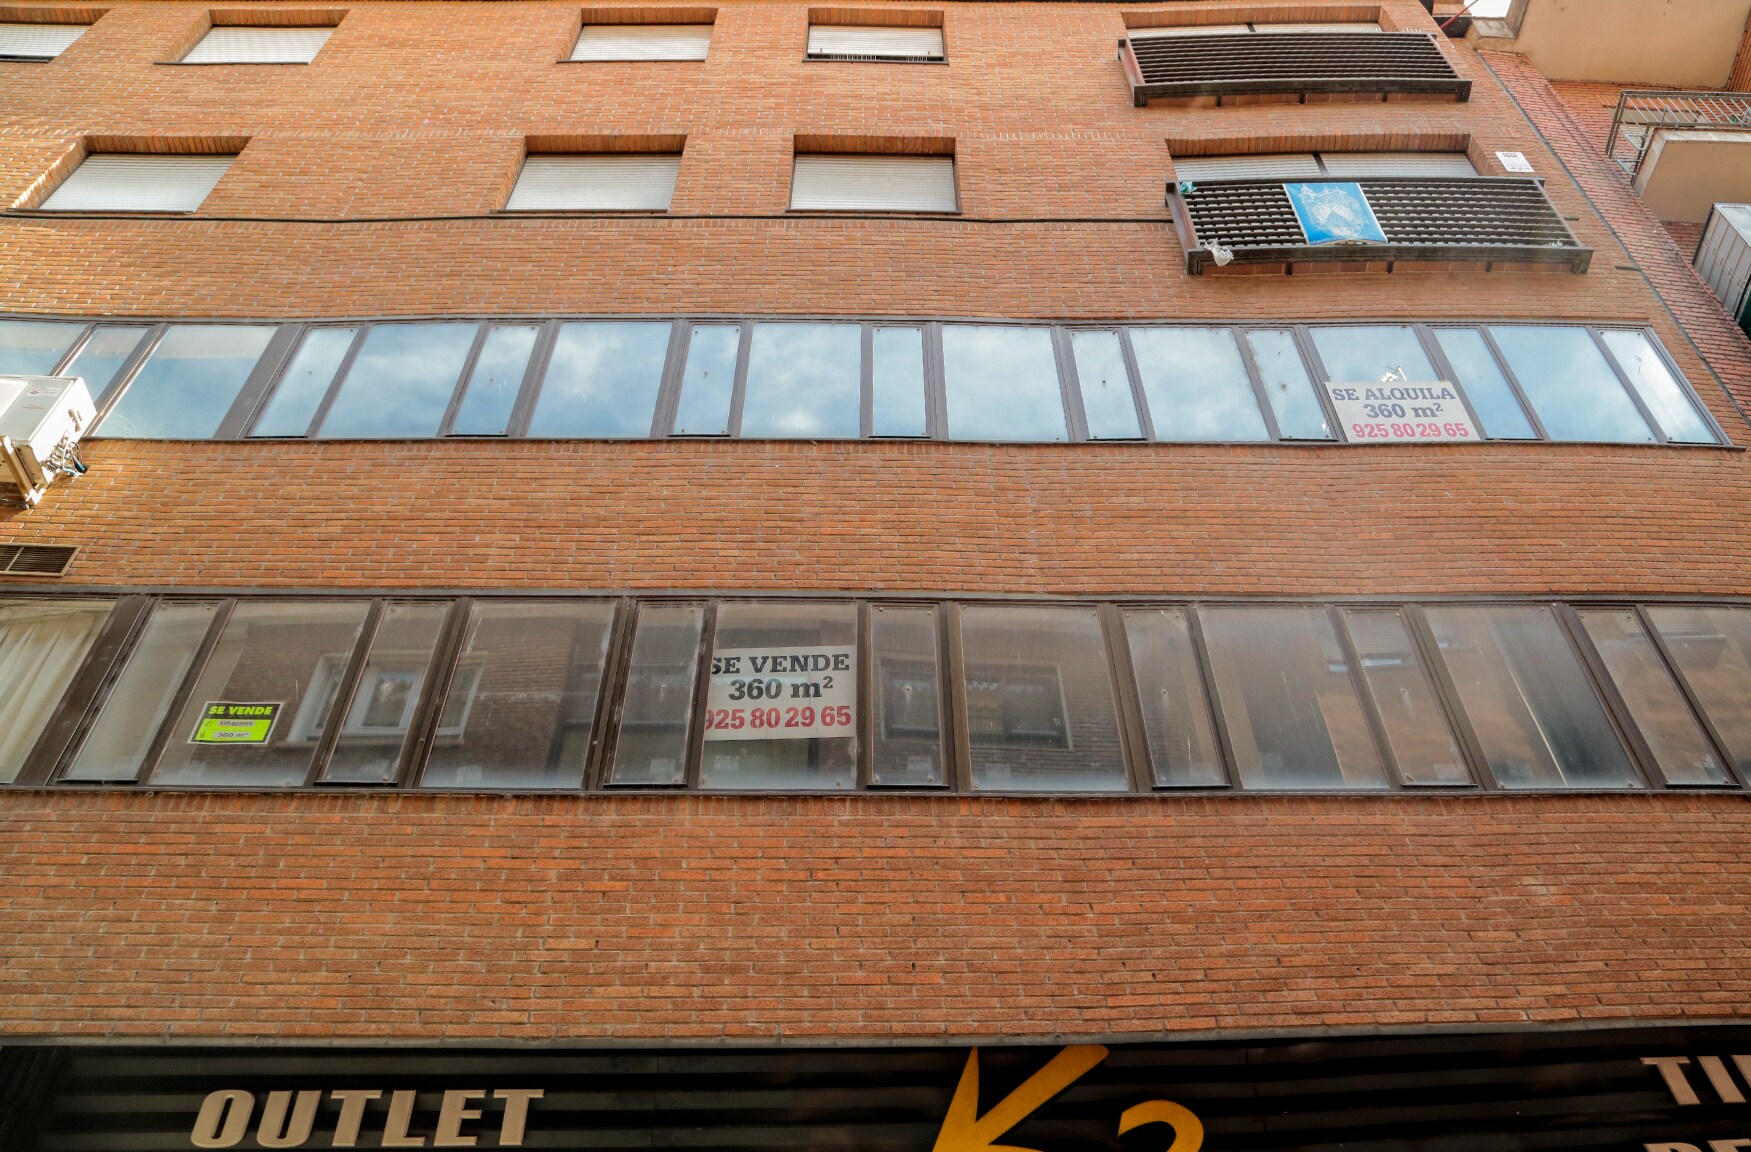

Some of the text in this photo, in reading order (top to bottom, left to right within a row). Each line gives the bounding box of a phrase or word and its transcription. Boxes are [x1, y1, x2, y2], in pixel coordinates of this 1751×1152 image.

[1332, 387, 1456, 401] SE ALQUILA
[1363, 403, 1406, 419] 360
[1352, 422, 1469, 438] 925 80 29 65
[712, 653, 850, 675] SE VENDE
[728, 678, 782, 701] 360
[208, 705, 273, 715] SE VENDE
[750, 707, 781, 729] 80
[784, 706, 816, 728] 29
[820, 705, 852, 727] 65
[190, 1088, 545, 1148] OUTLET
